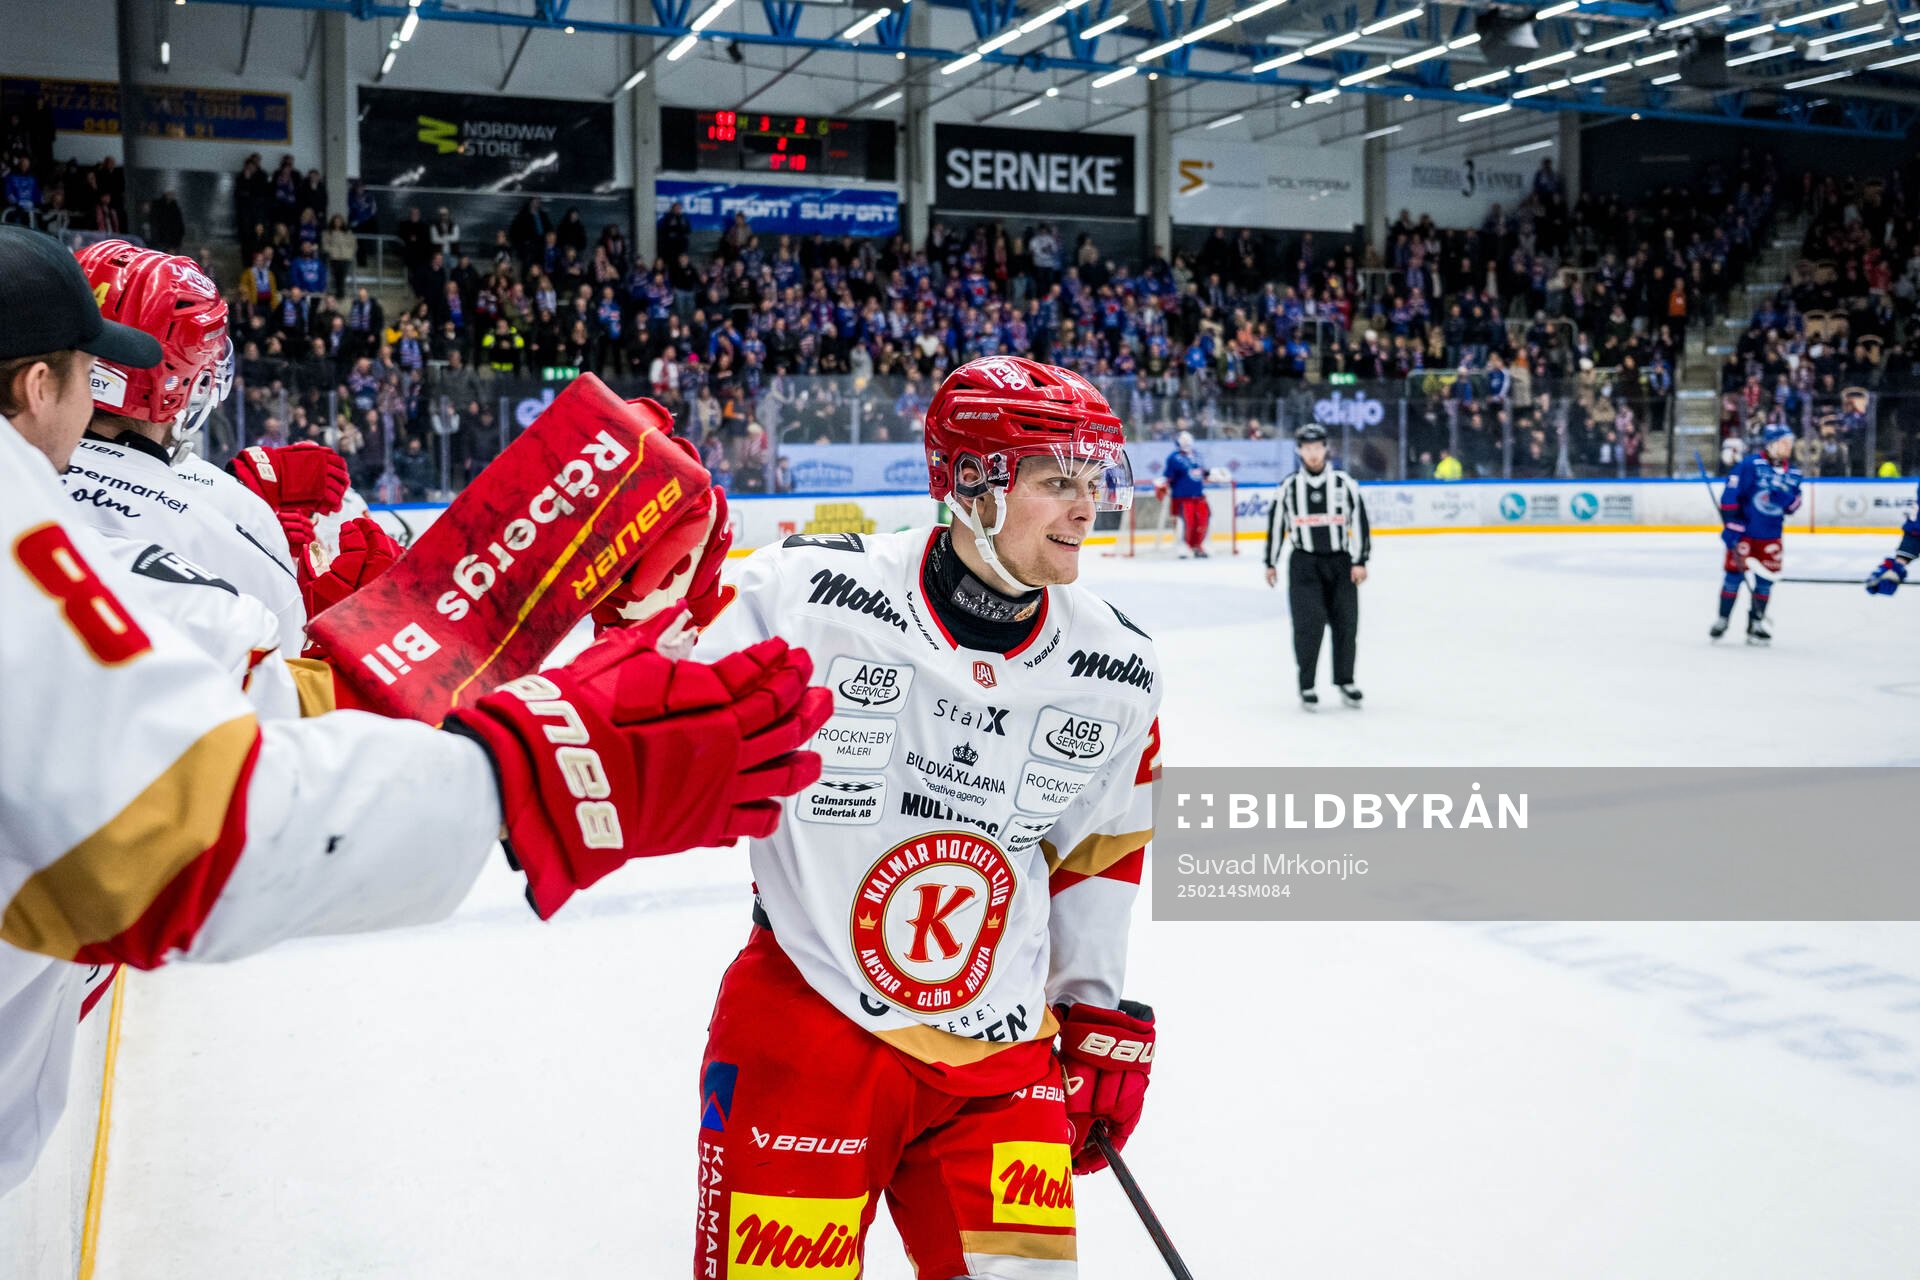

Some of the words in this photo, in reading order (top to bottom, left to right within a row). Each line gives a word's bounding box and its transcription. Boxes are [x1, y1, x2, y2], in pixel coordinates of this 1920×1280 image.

[463, 121, 557, 141] NORDWAY
[463, 140, 523, 157] STORE
[945, 147, 1116, 196] SERNEKE
[800, 201, 897, 222] SUPPORT
[64, 464, 190, 514] permarket
[436, 430, 631, 621] Råbergs
[570, 477, 684, 600] BAUER
[361, 621, 441, 686] Bil
[850, 685, 891, 698] SERVICE
[853, 665, 898, 687] AGB
[818, 728, 892, 744] ROCKNEBY
[1056, 736, 1096, 753] SERVICE
[1060, 717, 1102, 742] AGB
[494, 674, 624, 850] BAUE
[837, 745, 871, 756] MÅLERI
[906, 751, 1006, 794] BILDVÄXLARNA
[811, 795, 877, 806] Calmarsunds
[812, 807, 856, 818] Undertak
[858, 809, 871, 817] AB
[956, 791, 987, 806] agency
[864, 843, 930, 904] KALMAR
[936, 839, 997, 872] HOCKEY
[991, 867, 1010, 907] CLUB
[904, 883, 976, 962] K
[861, 949, 901, 993] ANSVAR
[917, 989, 950, 1006] GLÖD
[964, 946, 991, 993] HJÄRTA
[1078, 1032, 1156, 1063] BAU
[705, 1145, 724, 1280] KALMAR
[735, 1214, 858, 1269] Molin
